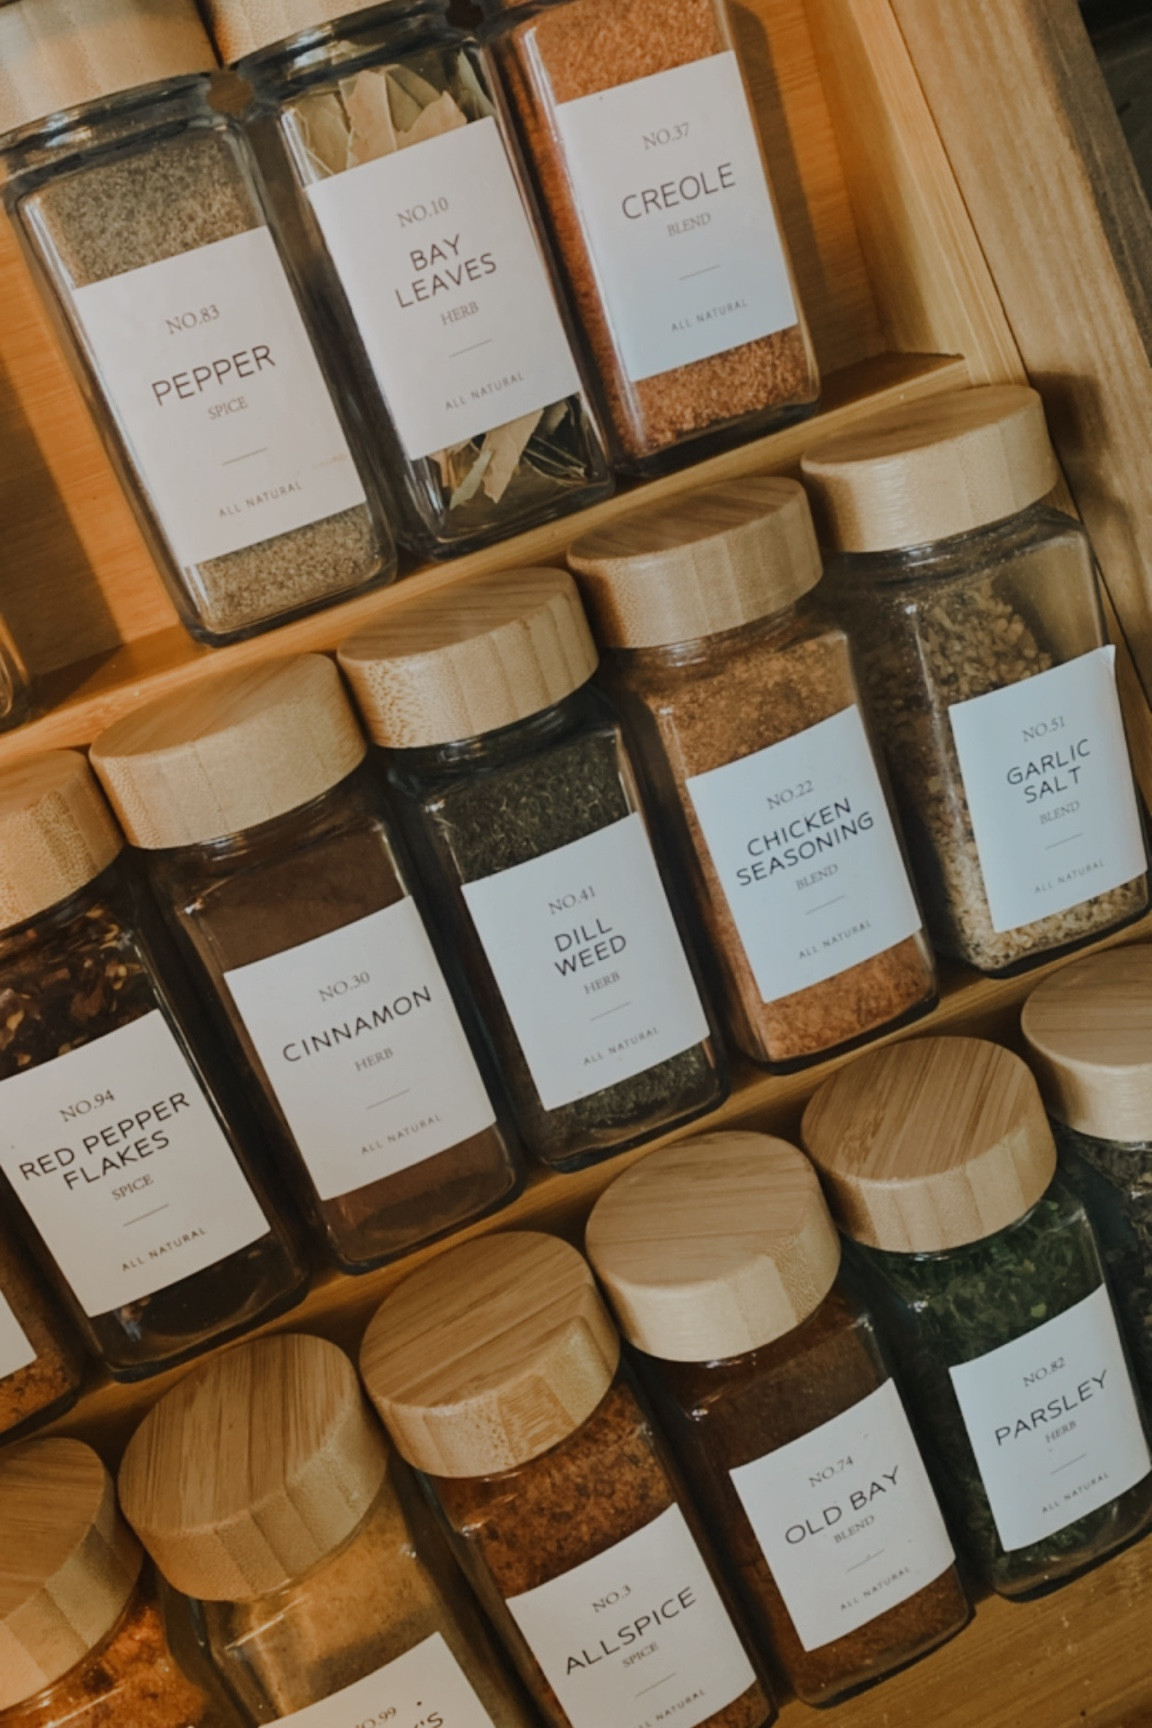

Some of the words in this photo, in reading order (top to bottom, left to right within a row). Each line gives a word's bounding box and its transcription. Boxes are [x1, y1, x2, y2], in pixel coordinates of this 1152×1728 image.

[642, 122, 689, 150] NO.37
[622, 162, 736, 220] CREOLE
[397, 197, 448, 227] NO.10
[667, 212, 711, 237] BLEND
[410, 234, 460, 271] BAY
[395, 252, 497, 308] LEAVES
[166, 304, 220, 334] NO.83
[440, 301, 479, 326] HERB
[671, 318, 691, 333] ALL
[696, 298, 748, 323] NATURAL
[151, 344, 276, 406] PEPPER
[445, 396, 466, 410] ALL
[471, 372, 524, 400] NATURAL
[208, 396, 248, 420] SPICE
[219, 503, 241, 518] ALL
[246, 481, 302, 509] NATURAL
[1022, 716, 1065, 742] NO.51
[1007, 738, 1090, 785] GARLIC
[766, 780, 814, 810] NO.22
[1024, 766, 1081, 804] SALT
[747, 797, 851, 857] CHICKEN
[1039, 801, 1080, 825] BLEND
[736, 811, 875, 886] SEASONING
[795, 863, 839, 890] BLEND
[1034, 881, 1053, 894] ALL
[1058, 859, 1104, 884] NATURAL
[548, 885, 595, 915] NO.41
[554, 918, 613, 952] DILL
[799, 945, 819, 959] ALL
[823, 920, 872, 948] NATURAL
[554, 934, 627, 977] WEED
[319, 971, 371, 1002] NO.30
[584, 971, 621, 995] HERB
[282, 985, 432, 1063] CINNAMON
[355, 1047, 394, 1072] HERB
[583, 1053, 604, 1066] ALL
[608, 1026, 659, 1054] NATURAL
[60, 1088, 115, 1123] NO.94
[18, 1147, 76, 1181] RED
[82, 1091, 190, 1155] PEPPER
[361, 1141, 383, 1155] ALL
[387, 1114, 442, 1142] NATURAL
[62, 1129, 170, 1191] FLAKES
[111, 1174, 154, 1201] SPICE
[122, 1256, 144, 1272] ALL
[148, 1227, 206, 1259] NATURAL
[1022, 1357, 1065, 1388] NO.82
[994, 1369, 1107, 1446] PARSLEY
[1045, 1420, 1077, 1444] HERB
[808, 1455, 854, 1488] NO.74
[785, 1505, 842, 1544] OLD
[849, 1465, 899, 1511] BAY
[1042, 1501, 1060, 1514] ALL
[1064, 1471, 1109, 1501] NATURAL
[834, 1514, 875, 1544] BLEND
[592, 1584, 632, 1613] NO.3
[840, 1597, 859, 1612] ALL
[863, 1566, 910, 1597] NATURAL
[565, 1586, 696, 1675] ALLSPICE
[622, 1642, 660, 1668] SPICE
[655, 1689, 705, 1721] NATURAL
